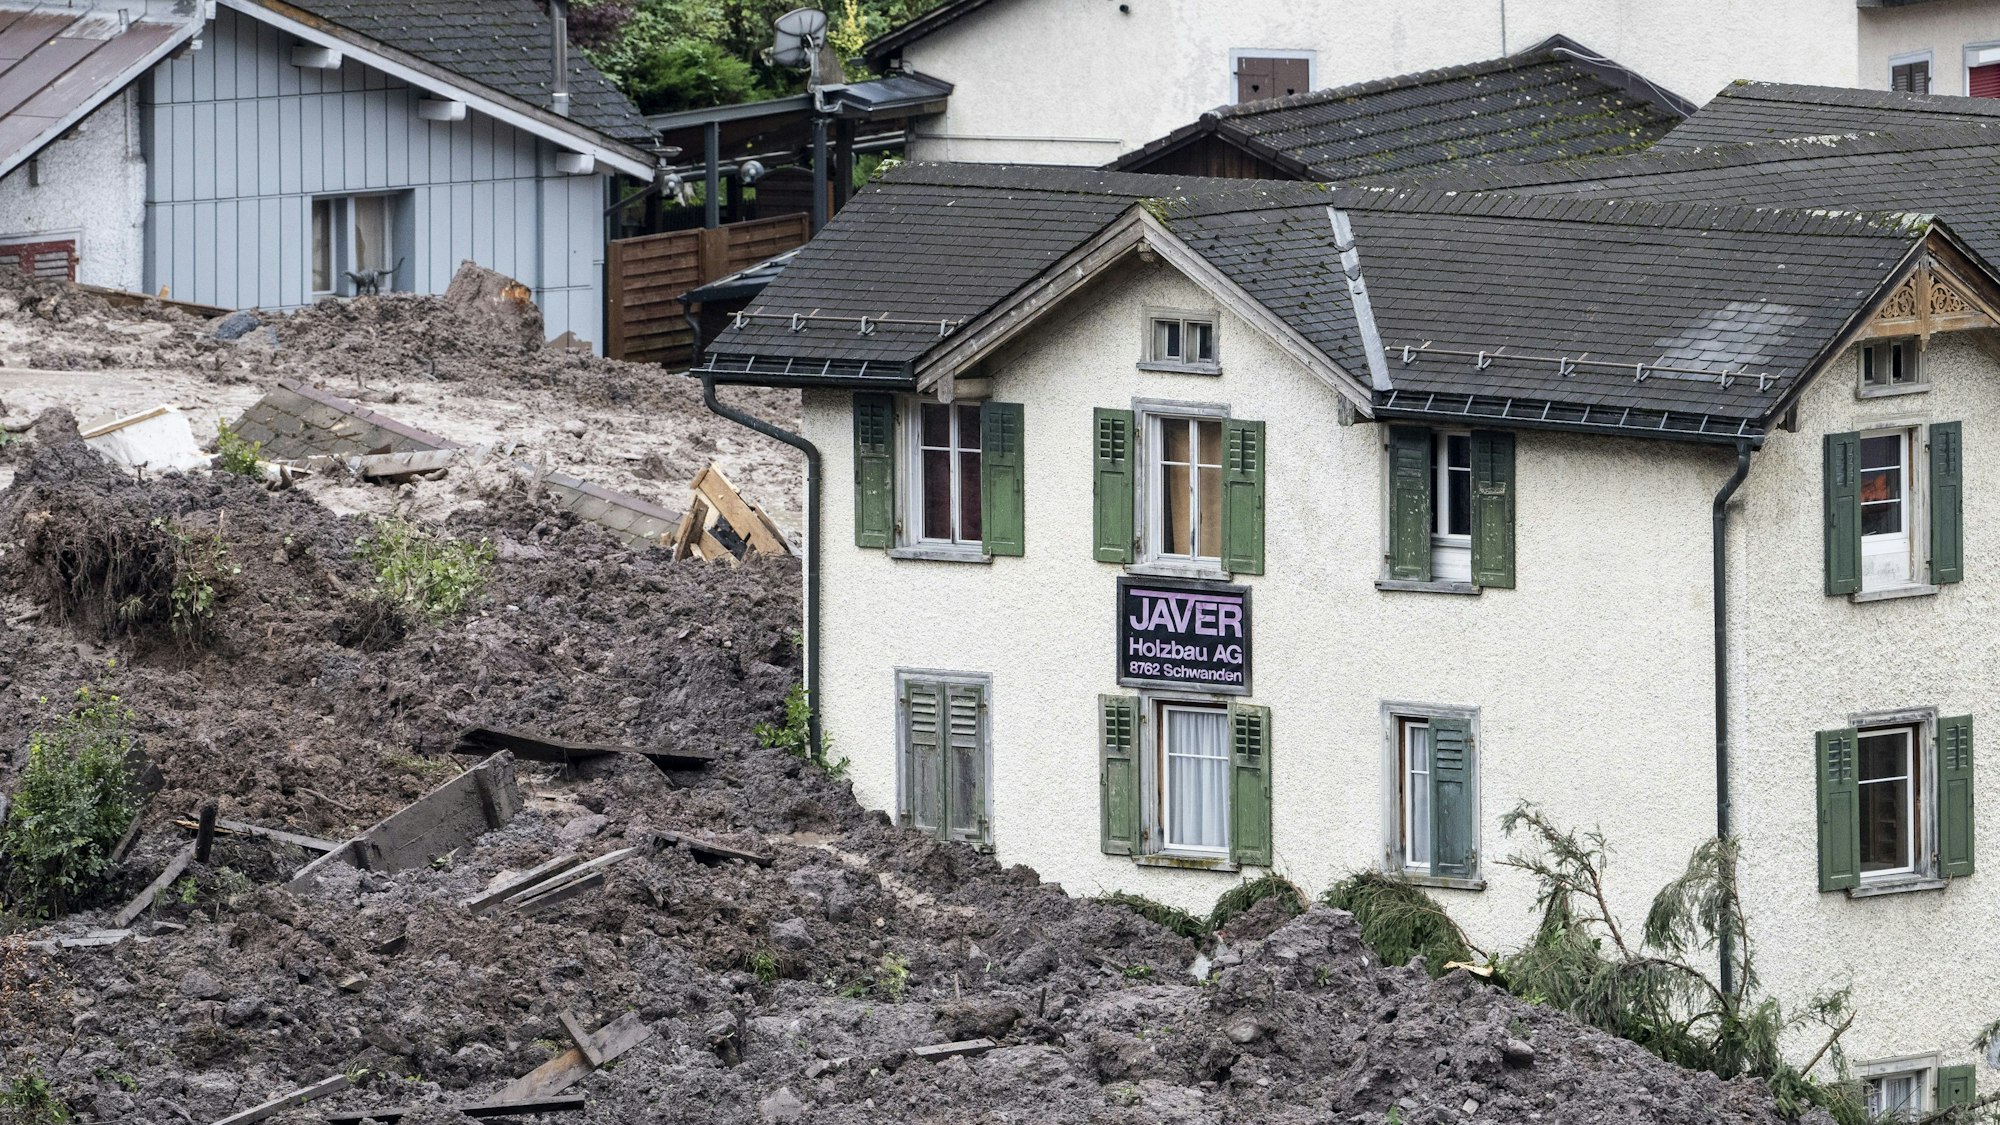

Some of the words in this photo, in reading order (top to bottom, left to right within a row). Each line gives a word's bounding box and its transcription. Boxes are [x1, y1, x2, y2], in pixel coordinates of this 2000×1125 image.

[1129, 590, 1243, 638] JAVER
[1129, 637, 1208, 662] Holzbau
[1213, 644, 1243, 664] AG
[1129, 661, 1160, 675] 8762
[1163, 664, 1242, 682] Schwanden
